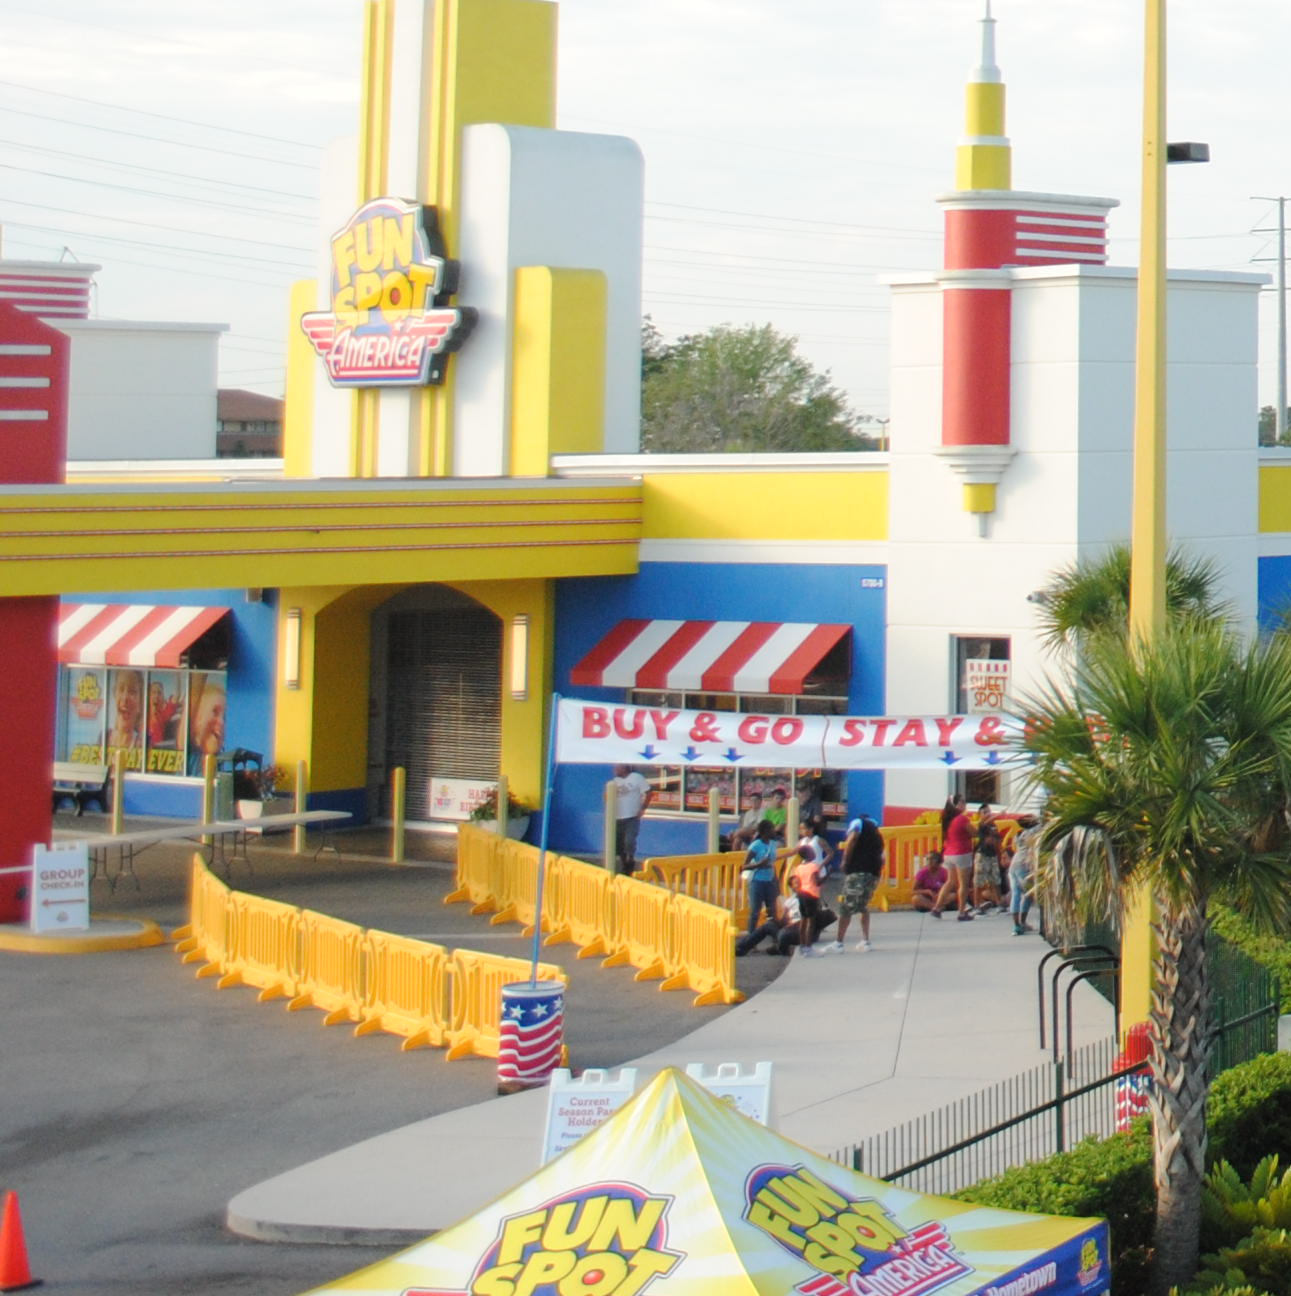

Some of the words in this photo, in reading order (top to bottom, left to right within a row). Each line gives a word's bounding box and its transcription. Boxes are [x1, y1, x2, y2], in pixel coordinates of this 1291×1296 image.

[332, 213, 414, 287] FUN
[334, 263, 437, 334] SPOT
[327, 328, 425, 372] AMERICA
[969, 676, 1008, 692] SWEET
[974, 692, 1004, 708] SPOT
[583, 707, 680, 740] BUY
[689, 712, 723, 743] &
[738, 715, 804, 745] GO
[839, 717, 964, 747] STAY
[974, 716, 1008, 746] &
[147, 749, 184, 772] EVER
[40, 868, 85, 881] GROUP
[557, 1106, 594, 1117] Season
[569, 1097, 610, 1106] Current
[567, 1117, 605, 1127] Holder
[747, 1167, 850, 1251] FUN
[498, 1195, 668, 1266] FUN
[803, 1200, 909, 1286] SPOT
[472, 1248, 679, 1296] SPOT
[848, 1246, 955, 1296] AMERICA
